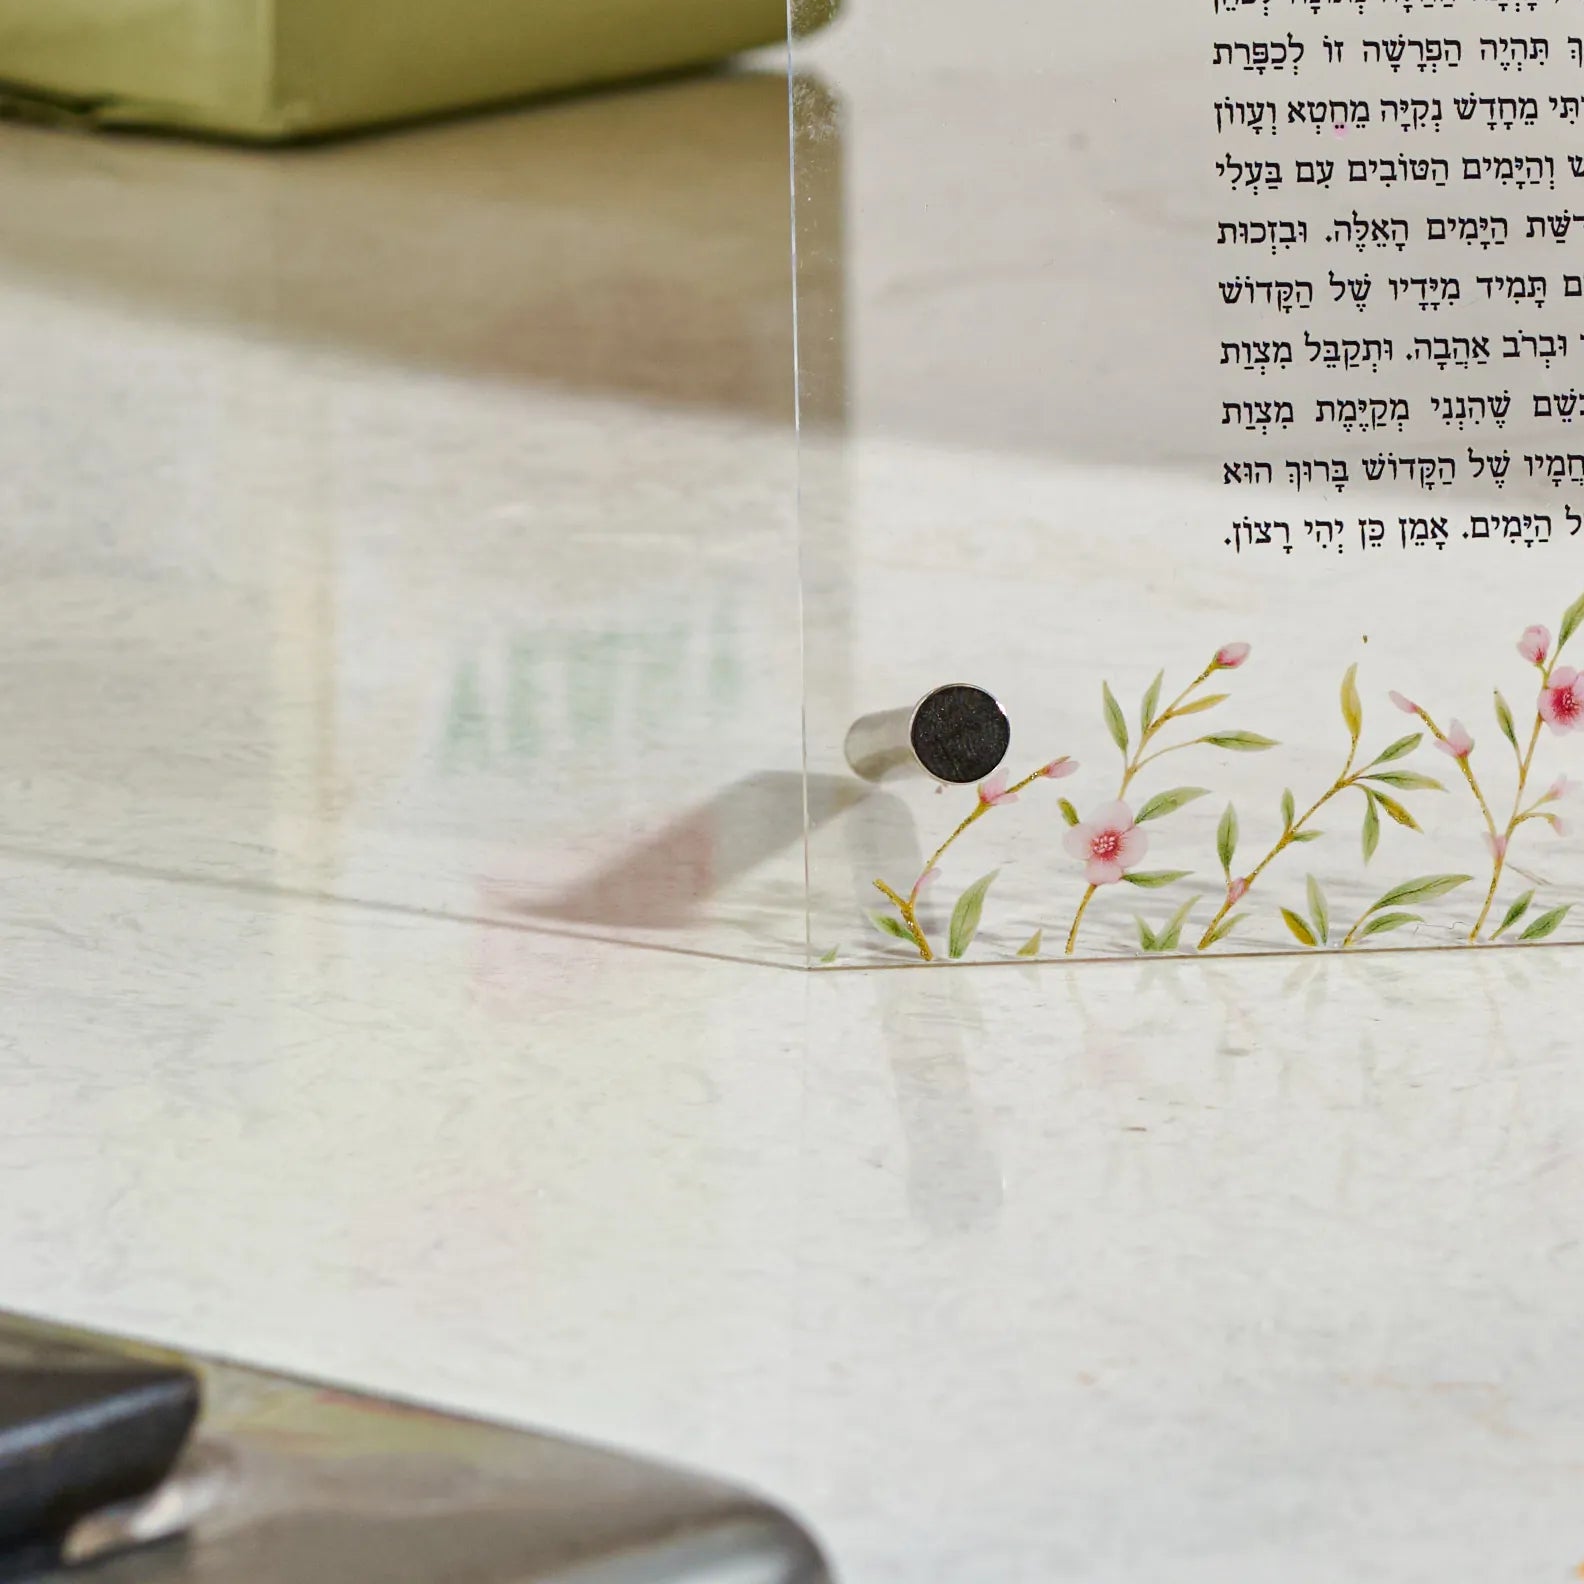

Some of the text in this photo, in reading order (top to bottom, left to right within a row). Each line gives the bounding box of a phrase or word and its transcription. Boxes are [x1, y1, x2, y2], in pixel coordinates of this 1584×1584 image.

[1322, 34, 1345, 64] זוֹ
[1295, 159, 1335, 190] עִם
[1327, 269, 1372, 313] שֶׁל
[1223, 460, 1273, 485] הוּא
[1467, 446, 1511, 489] שֶׁל
[1223, 515, 1294, 555] רָצוֹן.
[1303, 518, 1344, 555] יְהִי
[1357, 517, 1385, 551] כֵּן
[1398, 516, 1449, 551] אָמֵן
